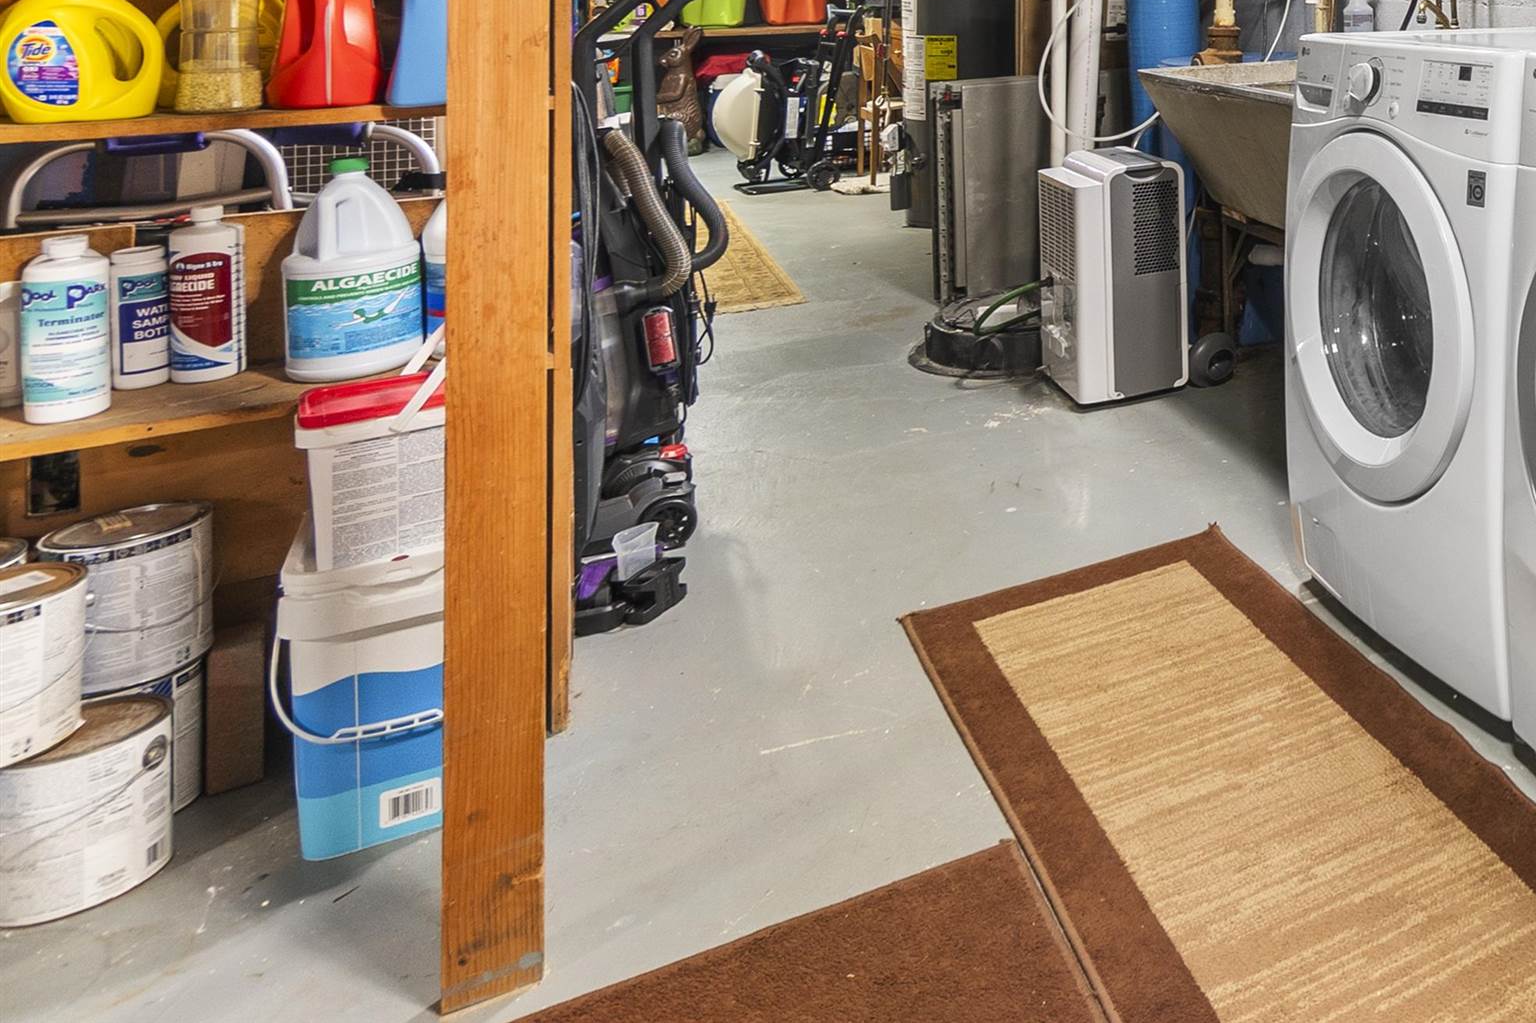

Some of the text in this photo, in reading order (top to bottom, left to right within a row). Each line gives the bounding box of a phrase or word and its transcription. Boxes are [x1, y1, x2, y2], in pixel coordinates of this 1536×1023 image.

[22, 43, 51, 59] Tide
[310, 263, 418, 292] ALGAECIDE
[38, 312, 105, 327] Terminator
